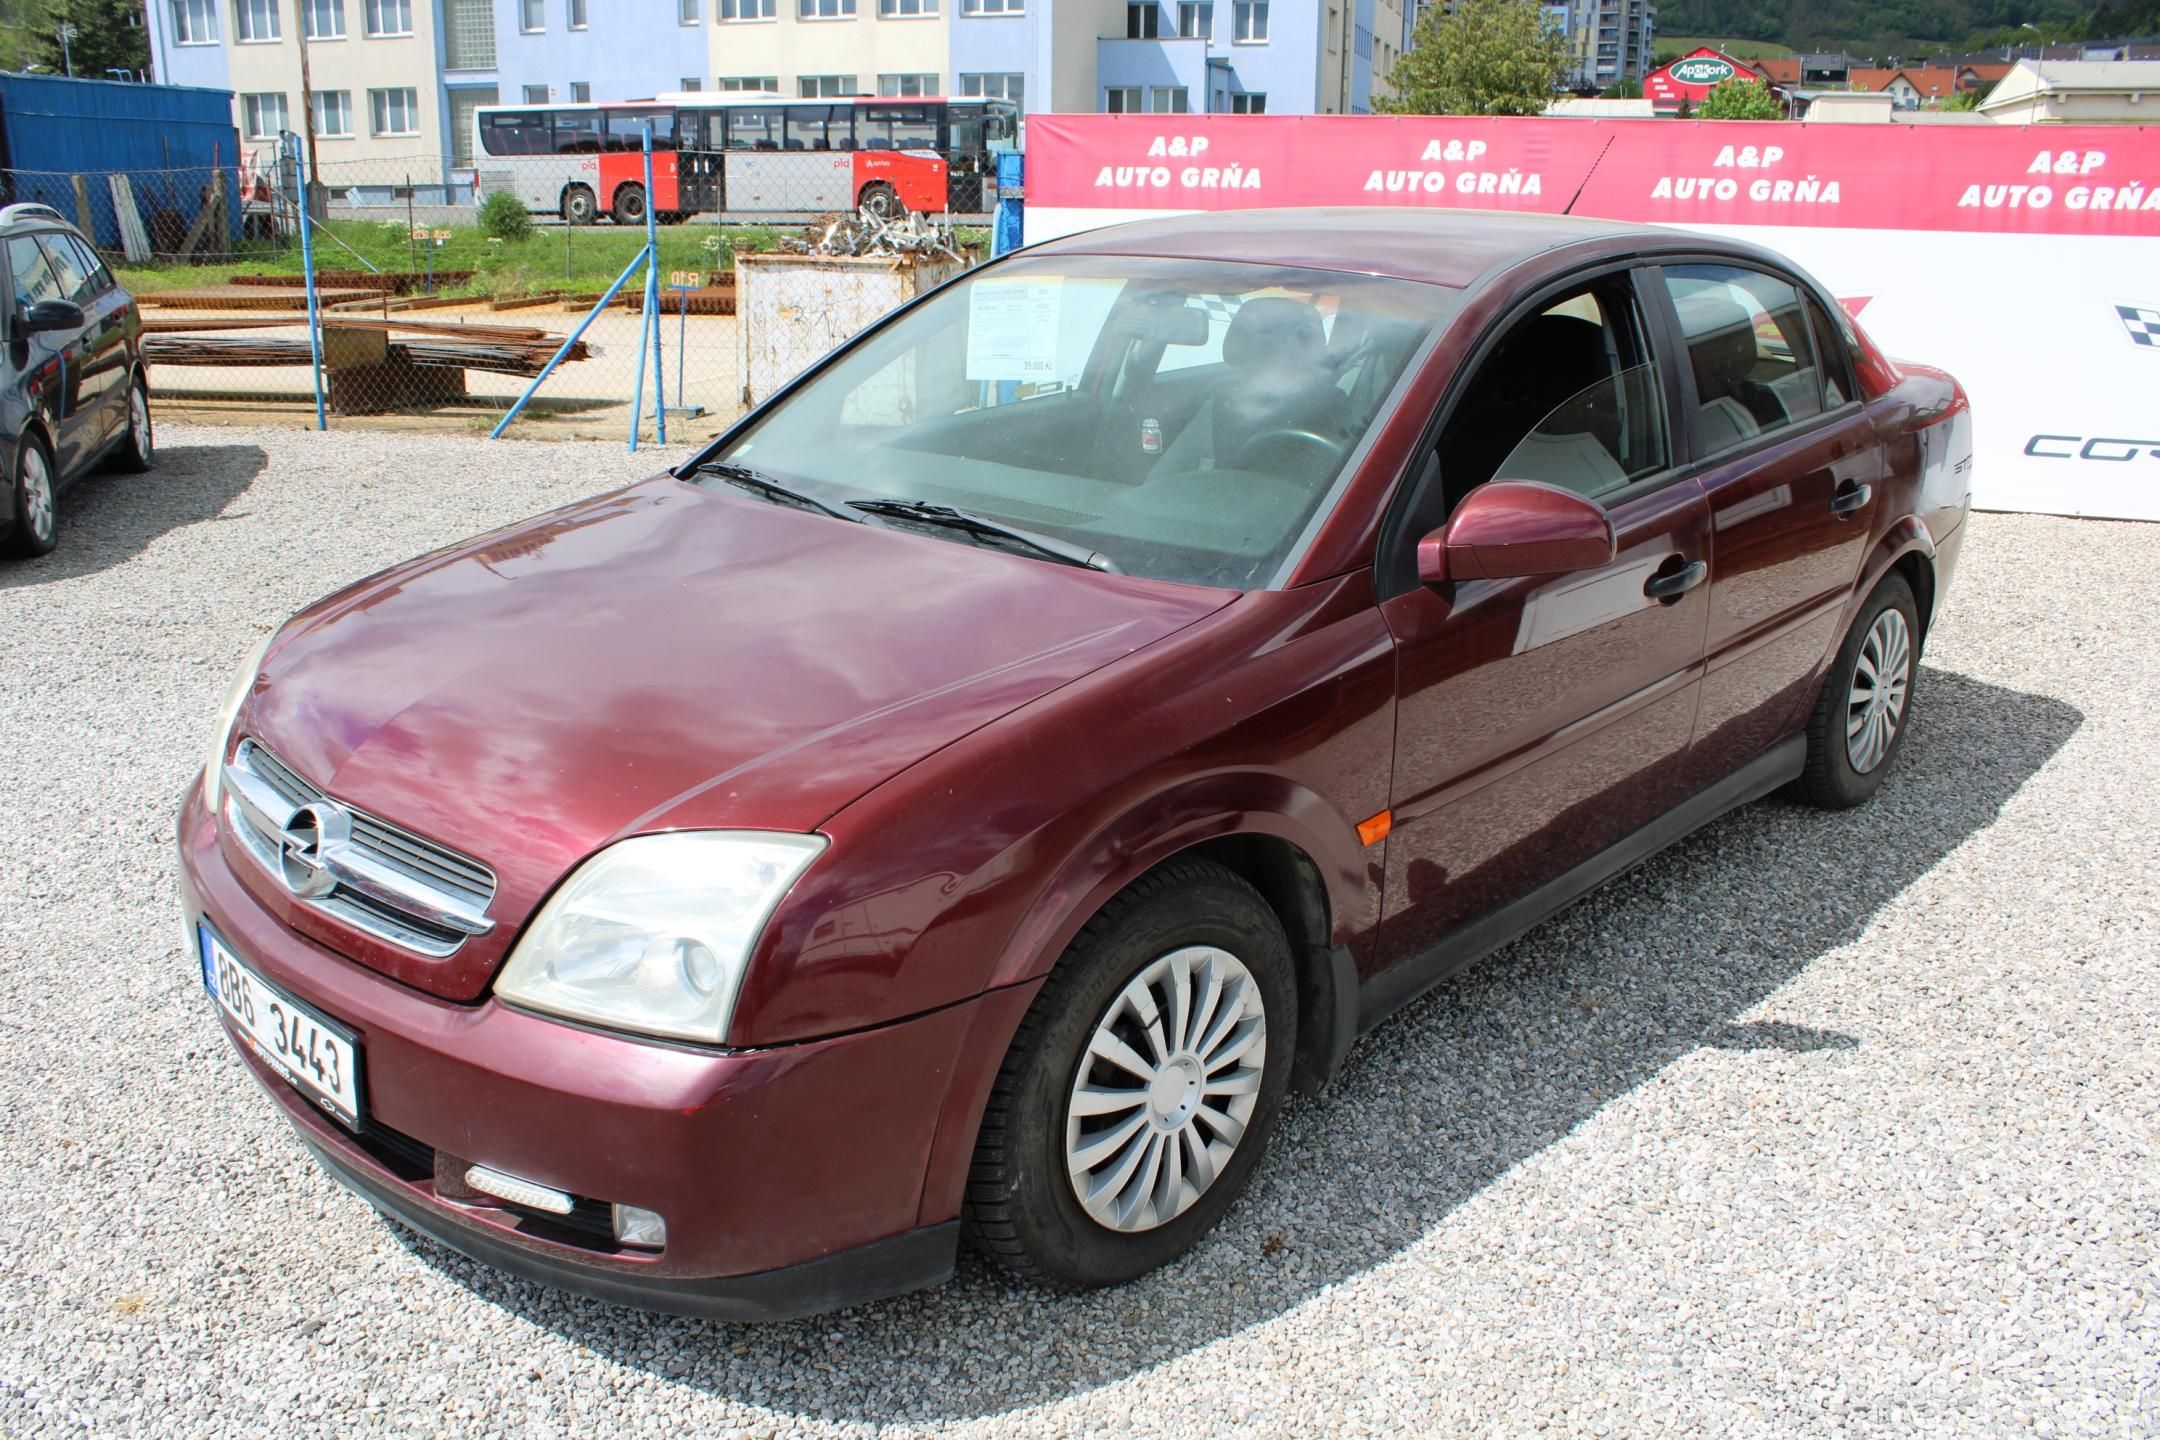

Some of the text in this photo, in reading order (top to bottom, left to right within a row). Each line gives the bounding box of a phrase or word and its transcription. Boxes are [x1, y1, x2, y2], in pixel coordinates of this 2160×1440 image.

[1147, 136, 1209, 157] A&P
[1420, 139, 1487, 161] A&P
[1712, 145, 1784, 168] A&P
[1094, 162, 1262, 189] AUTO GRŇA
[2026, 150, 2106, 175] A&P
[1363, 167, 1542, 195] AUTO GRŇA
[1650, 174, 1841, 204] AUTO GRŇA
[1957, 180, 2160, 211] AUTO GRŇA
[218, 951, 255, 1028] 8B6
[270, 1003, 341, 1094] 3443
